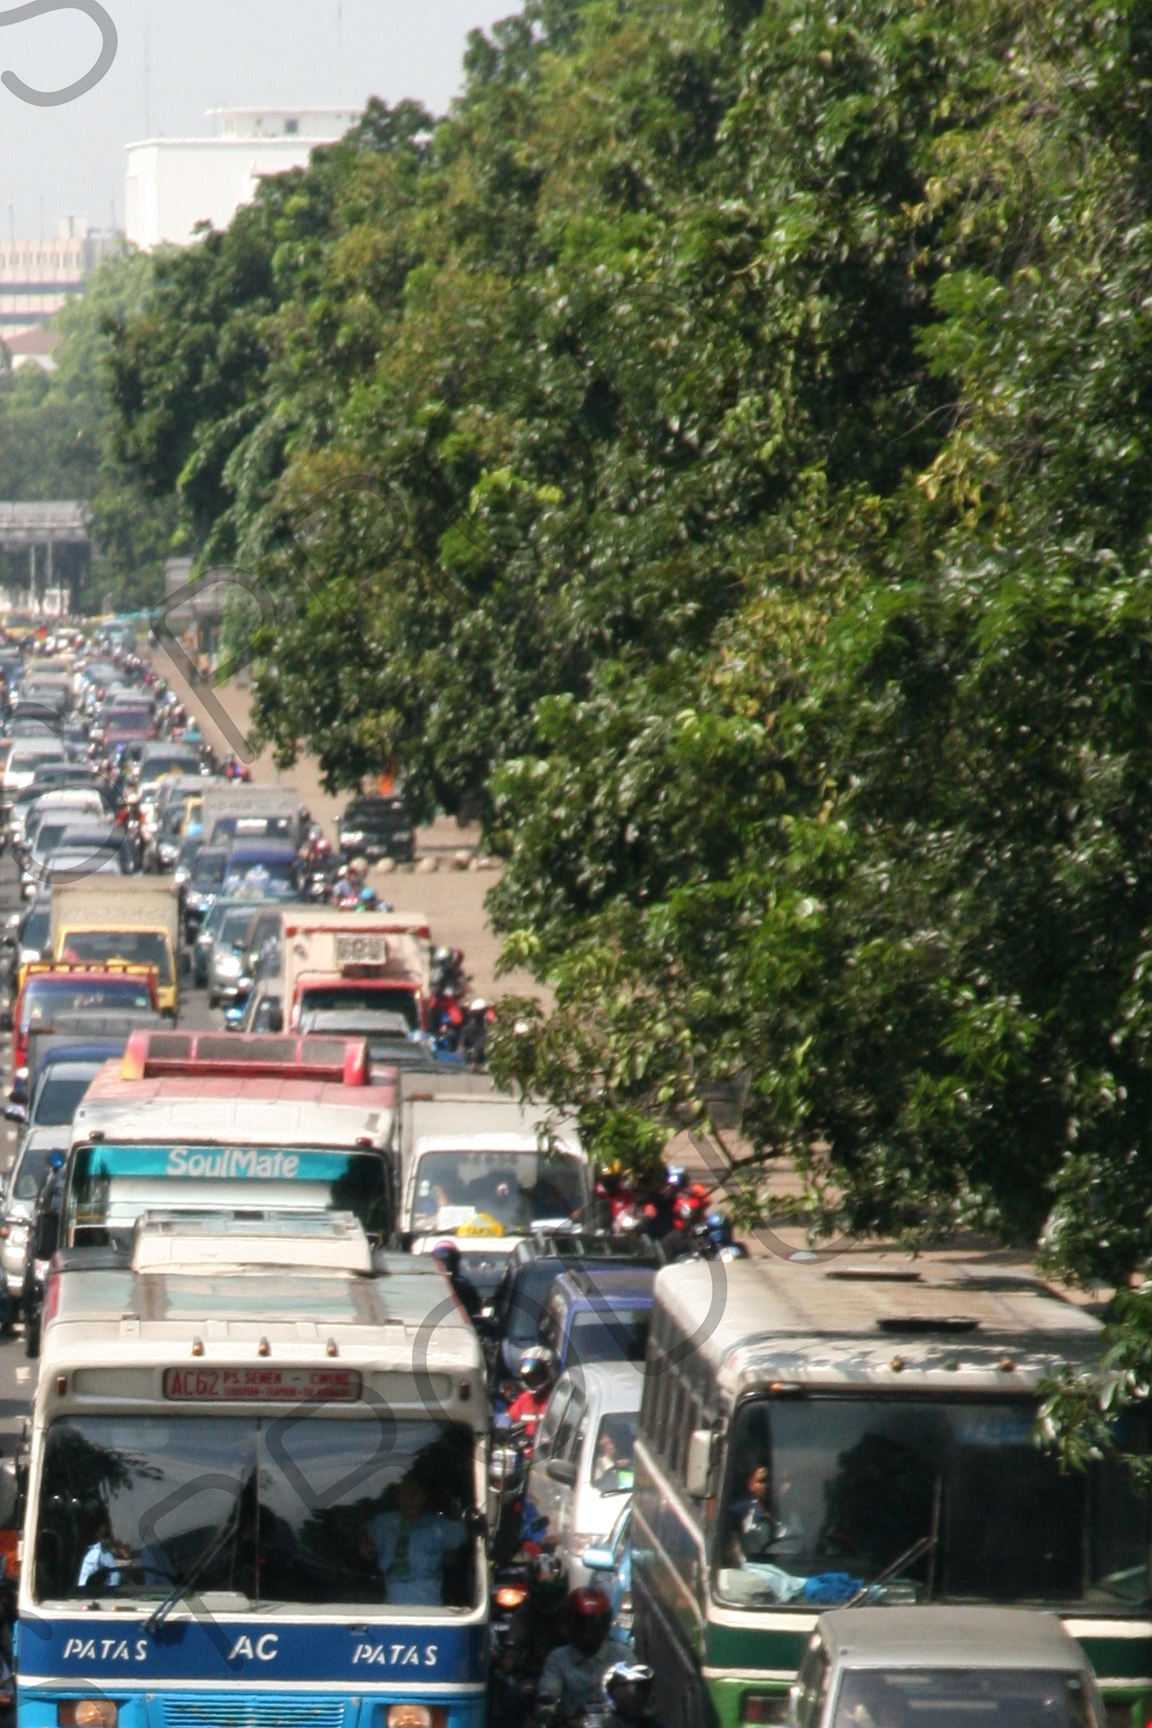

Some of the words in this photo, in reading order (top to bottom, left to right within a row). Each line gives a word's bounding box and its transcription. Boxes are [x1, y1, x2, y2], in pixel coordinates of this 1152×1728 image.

[166, 1148, 300, 1179] SoulMate
[171, 1370, 219, 1395] AC62
[63, 1638, 148, 1661] PATAS
[228, 1633, 279, 1661] AC
[352, 1643, 438, 1665] PATAS
